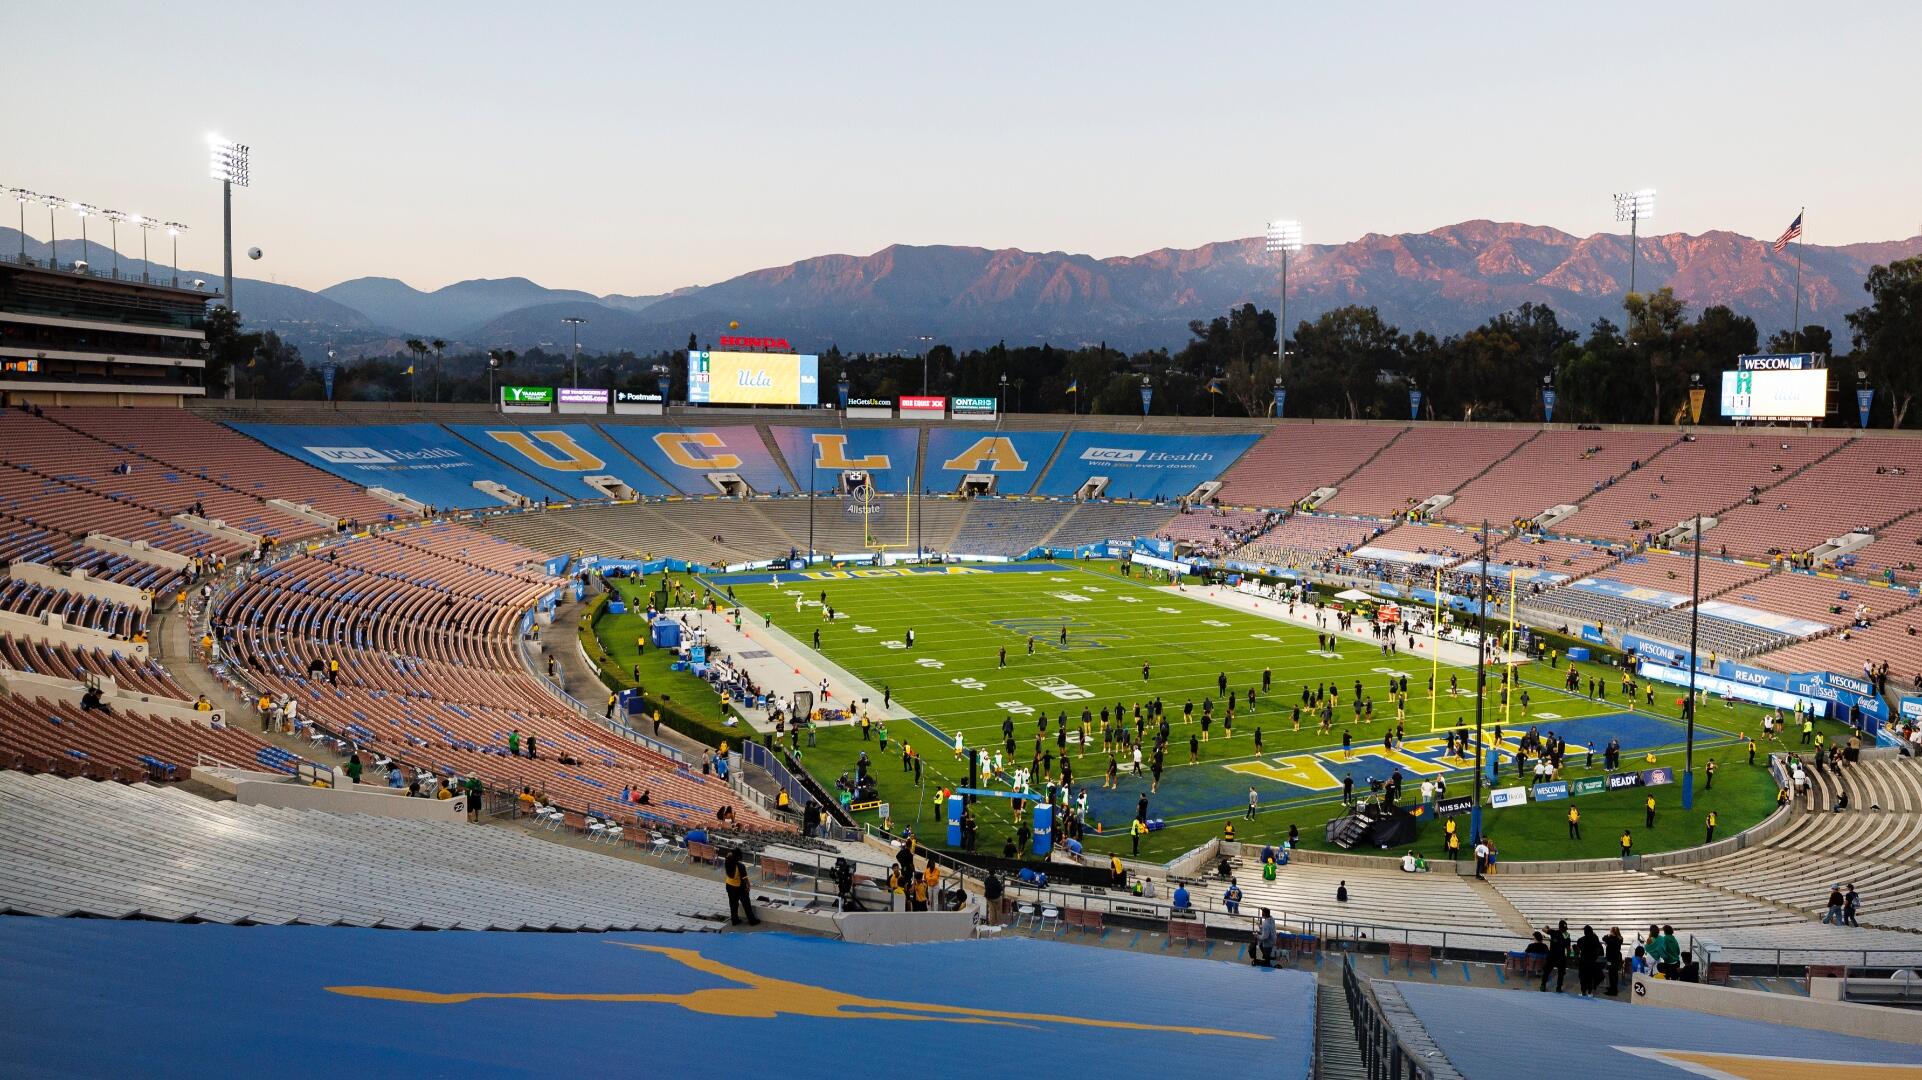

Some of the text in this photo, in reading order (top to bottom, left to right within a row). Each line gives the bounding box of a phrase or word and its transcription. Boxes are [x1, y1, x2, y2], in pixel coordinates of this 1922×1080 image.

[720, 336, 791, 349] HONDA
[1745, 358, 1790, 370] WESCOM
[737, 369, 772, 387] Ucla
[627, 392, 662, 401] Postmates
[847, 398, 891, 406] HeGetsUs.com
[955, 398, 991, 406] ONTARIO
[320, 447, 463, 460] UCLA Health
[1091, 450, 1214, 461] UCLA Health
[847, 504, 881, 515] Allstate
[800, 566, 994, 581] UCLA
[1639, 641, 1669, 659] WESCOM
[1735, 669, 1767, 685] READY
[1829, 673, 1860, 691] WESCOM
[1610, 775, 1637, 788] READY
[1536, 785, 1560, 795] WESCOM
[1439, 801, 1472, 813] NISSAN
[1635, 984, 1645, 995] 24
